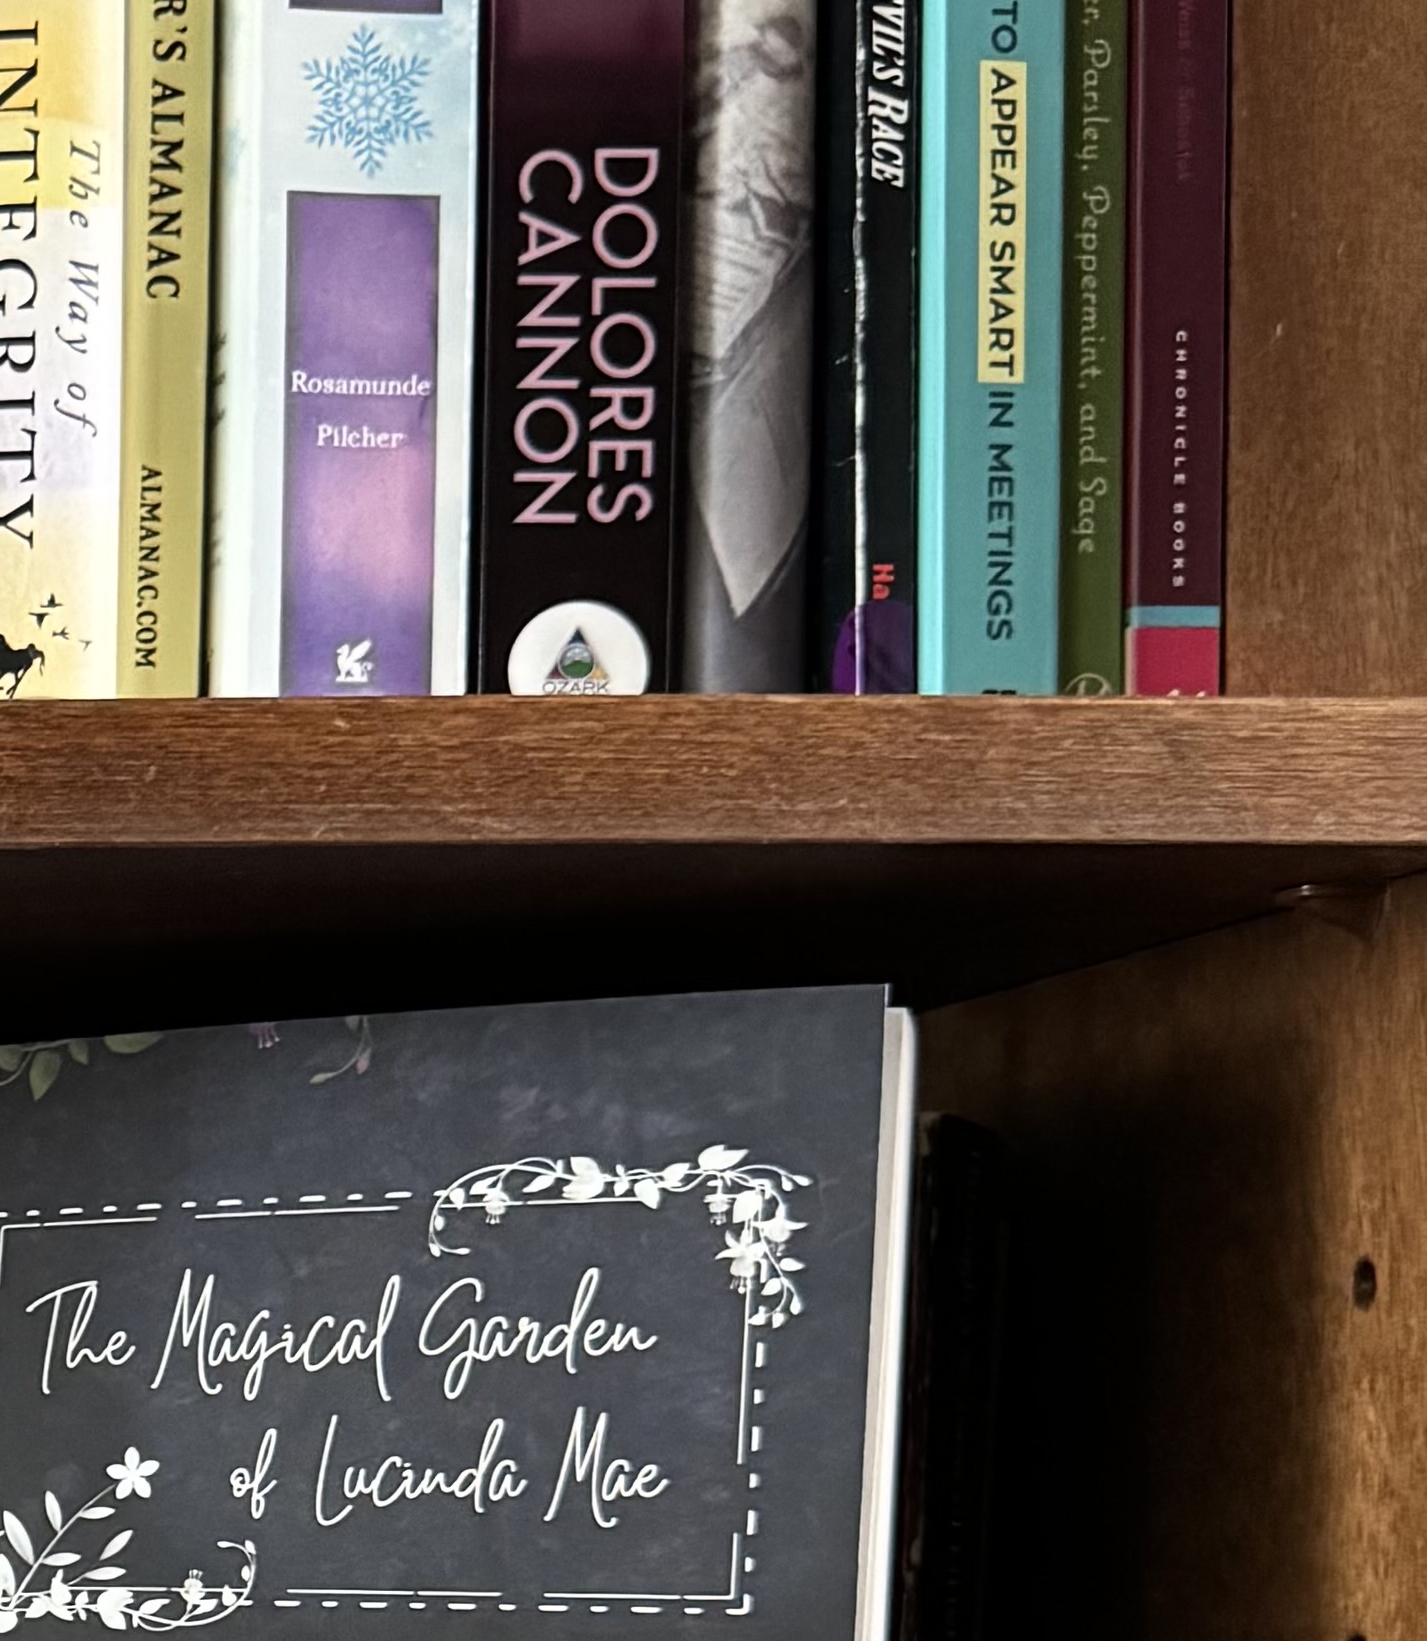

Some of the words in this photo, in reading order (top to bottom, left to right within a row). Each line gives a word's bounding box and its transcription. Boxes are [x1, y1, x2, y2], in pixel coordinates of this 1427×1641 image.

[991, 1, 1018, 54] TO
[988, 68, 1017, 227] APPEAR
[1075, 39, 1111, 171] Parsley,
[69, 140, 100, 229] The
[56, 262, 100, 355] Way
[512, 149, 583, 525] CANNON
[587, 147, 660, 525] DOLORES
[988, 240, 1016, 377] SMART
[1073, 185, 1111, 389] Peppermint,
[55, 381, 97, 437] of
[292, 370, 431, 397] Rosamunde
[317, 424, 404, 450] Pilcher
[988, 391, 1015, 428] IN
[1078, 403, 1103, 465] and
[1173, 330, 1189, 486] CHRONICLE
[135, 464, 163, 670] ALMANAC.COM
[986, 444, 1015, 641] MEETINGS
[1072, 471, 1107, 553] Sage
[1173, 502, 1186, 588] BOOKS
[26, 1279, 135, 1395] The
[150, 1269, 401, 1401] Magical
[418, 1267, 657, 1397] Garden
[231, 1427, 277, 1519] of
[316, 1415, 528, 1526] Lucinda
[545, 1406, 669, 1528] Mae
